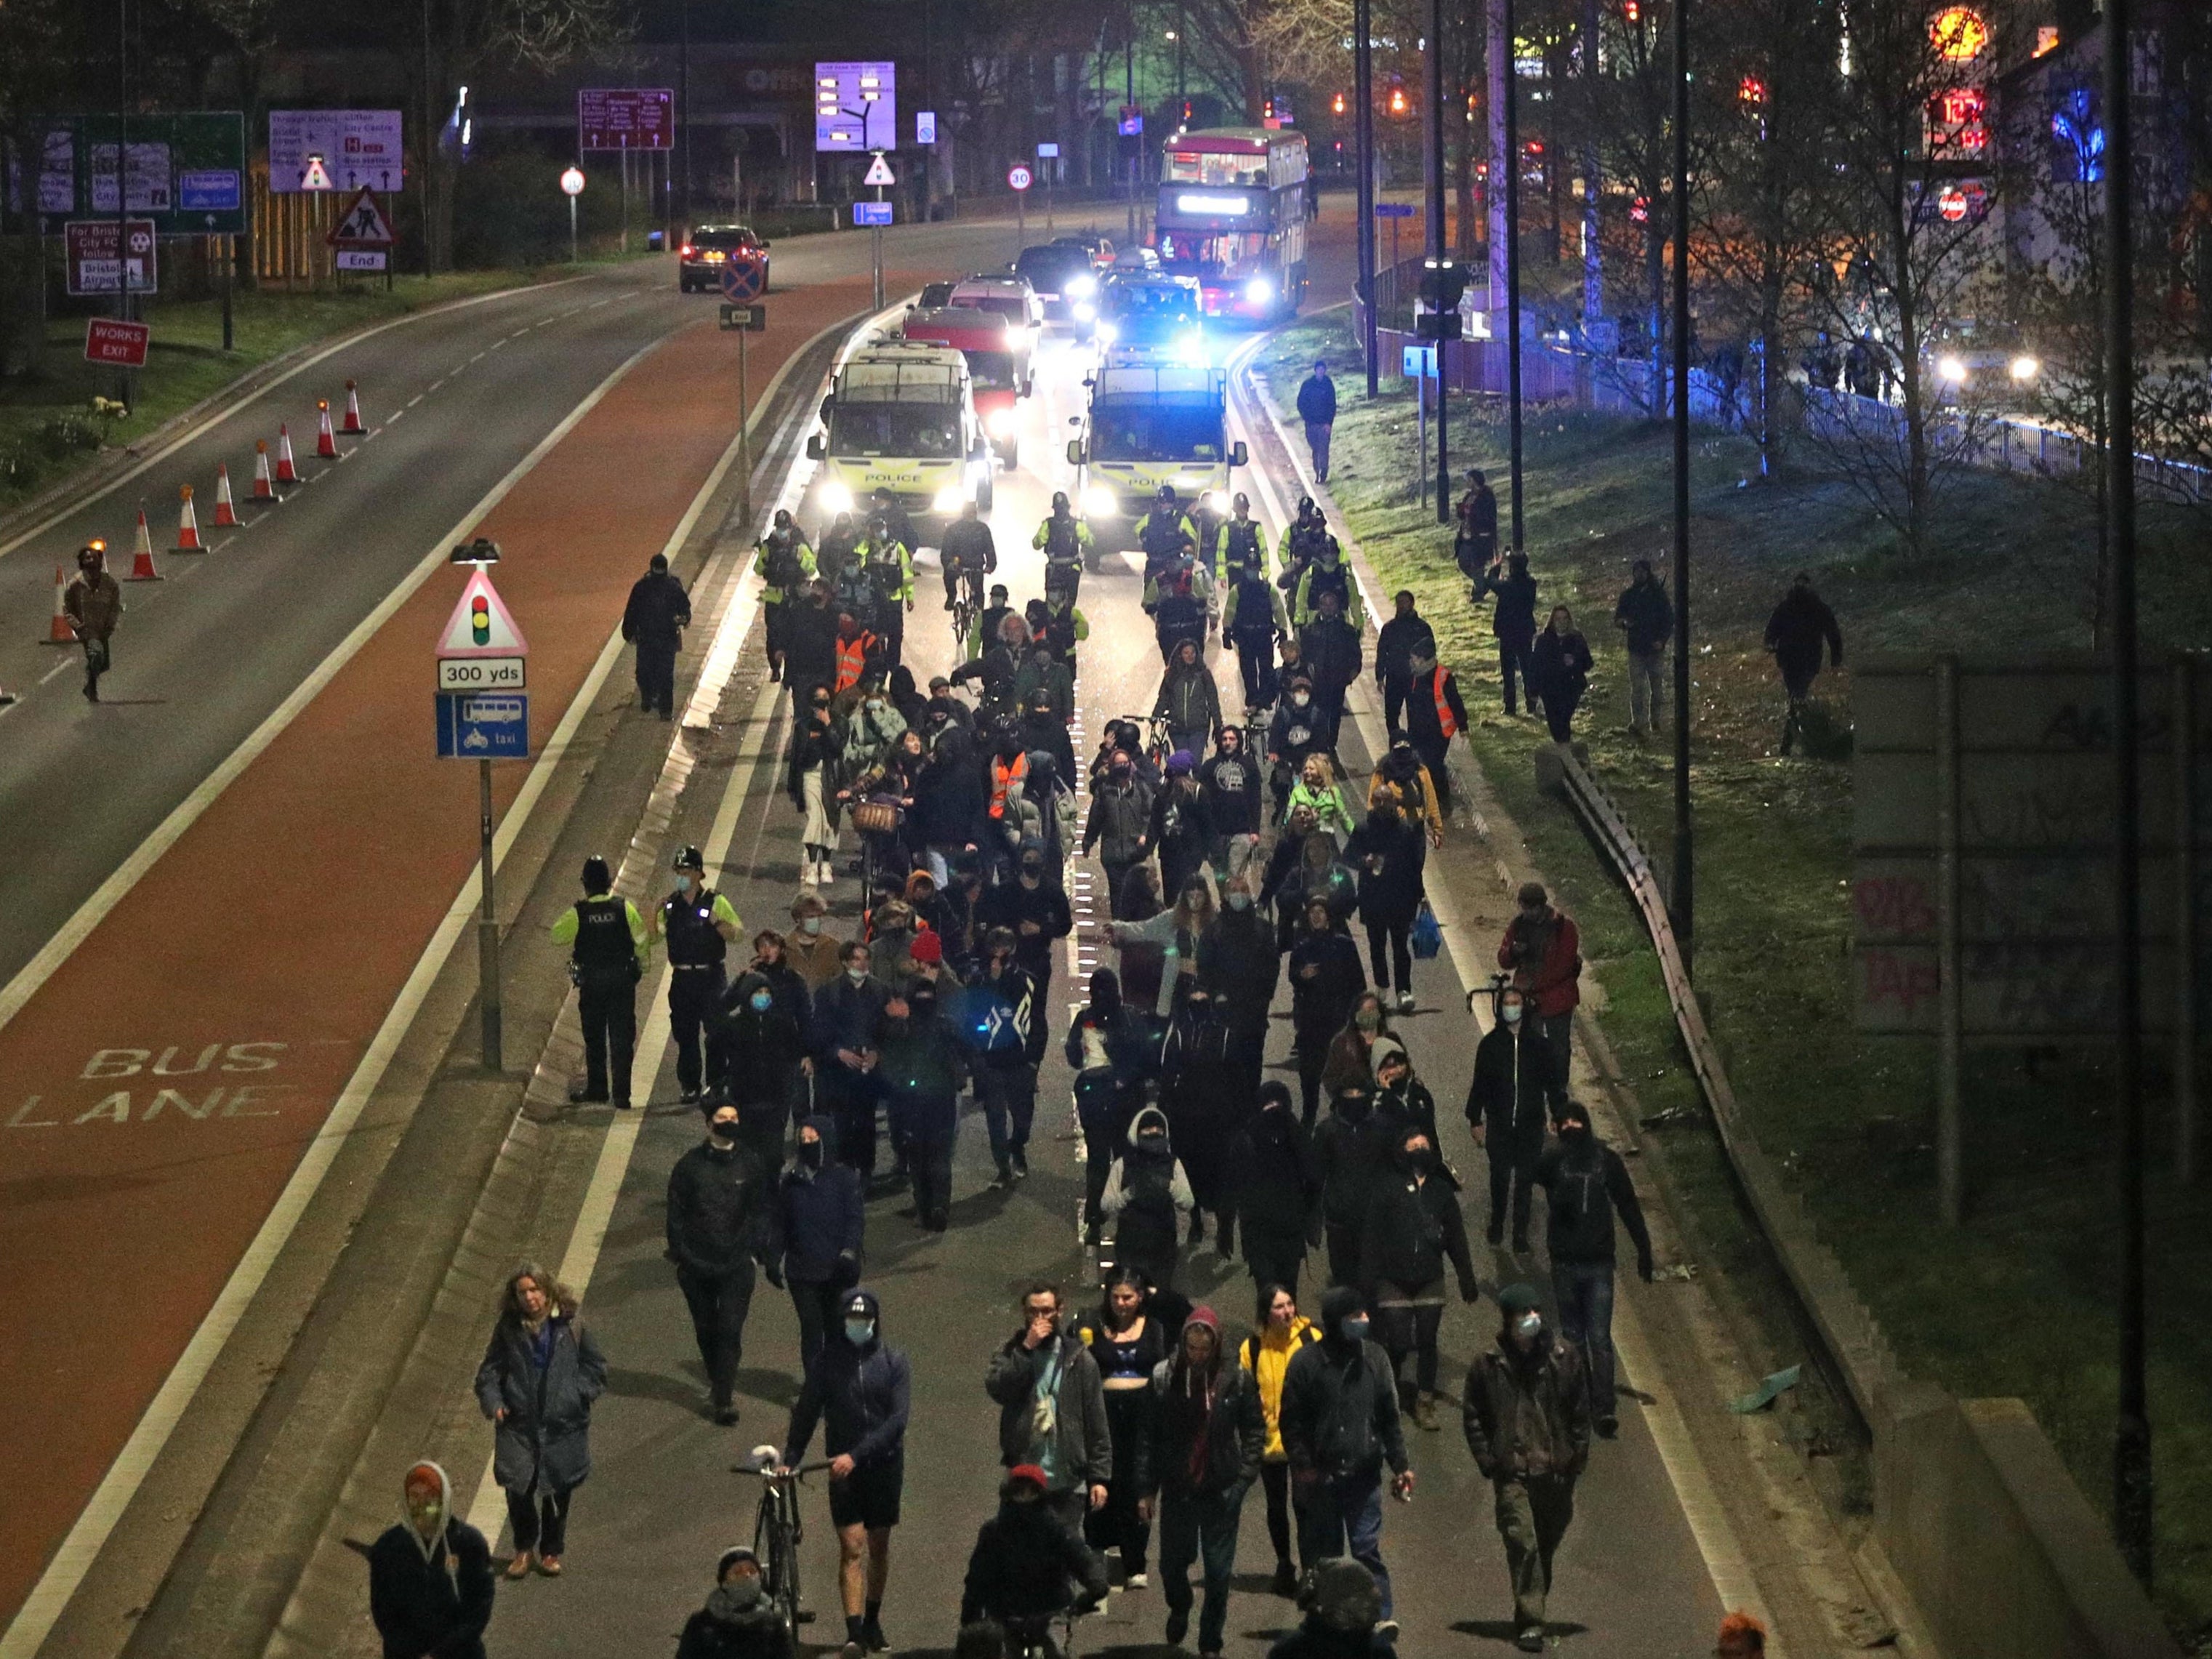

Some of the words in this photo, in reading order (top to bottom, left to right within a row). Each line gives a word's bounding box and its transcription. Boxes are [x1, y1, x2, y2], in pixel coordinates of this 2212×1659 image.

[1012, 174, 1029, 183] 30
[350, 254, 375, 266] End
[95, 326, 142, 343] WORKS
[102, 344, 129, 358] EXIT
[865, 474, 922, 483] POLICE
[447, 667, 482, 681] 300
[489, 667, 518, 682] yds
[495, 733, 516, 744] taxi
[79, 1042, 289, 1079] BUS
[4, 1085, 299, 1128] LANE
